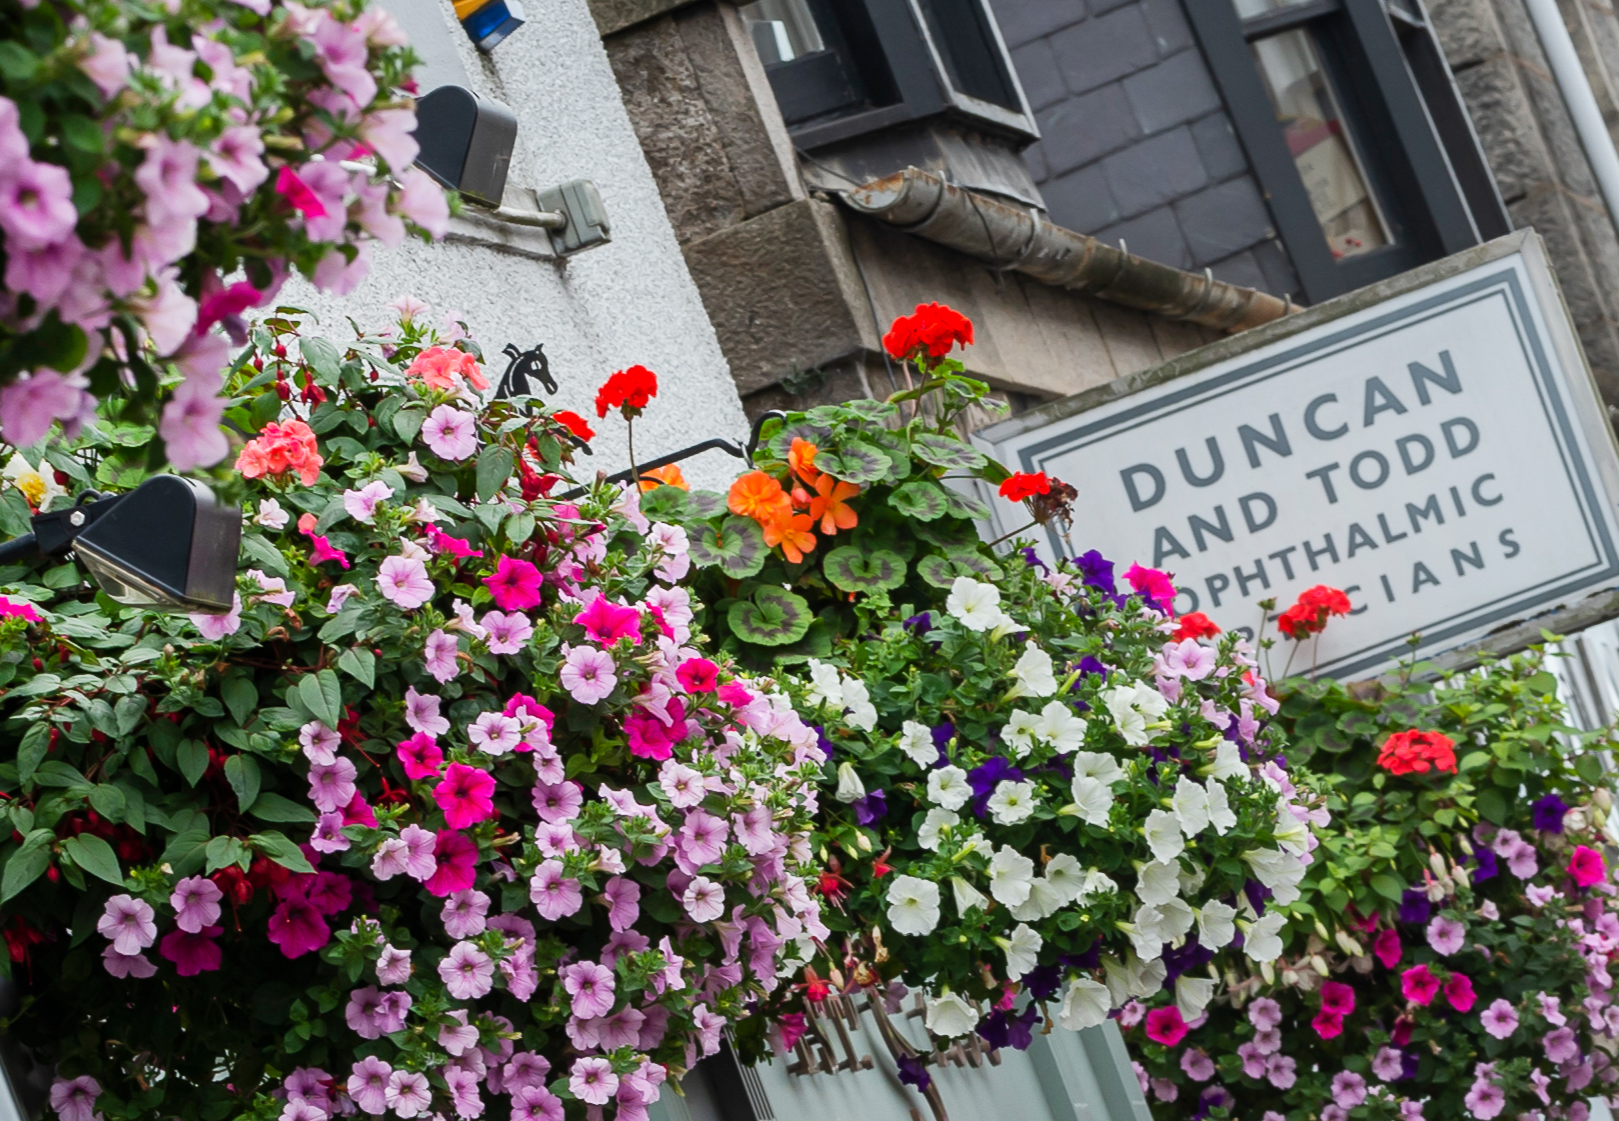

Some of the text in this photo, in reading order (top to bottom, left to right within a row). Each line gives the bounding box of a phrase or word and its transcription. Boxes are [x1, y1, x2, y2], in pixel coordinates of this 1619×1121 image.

[1119, 349, 1463, 513] DUNCAN
[1152, 416, 1480, 568] AND TODD
[1175, 473, 1504, 618] OPHTHALMIC
[1203, 528, 1521, 650] CIANS
